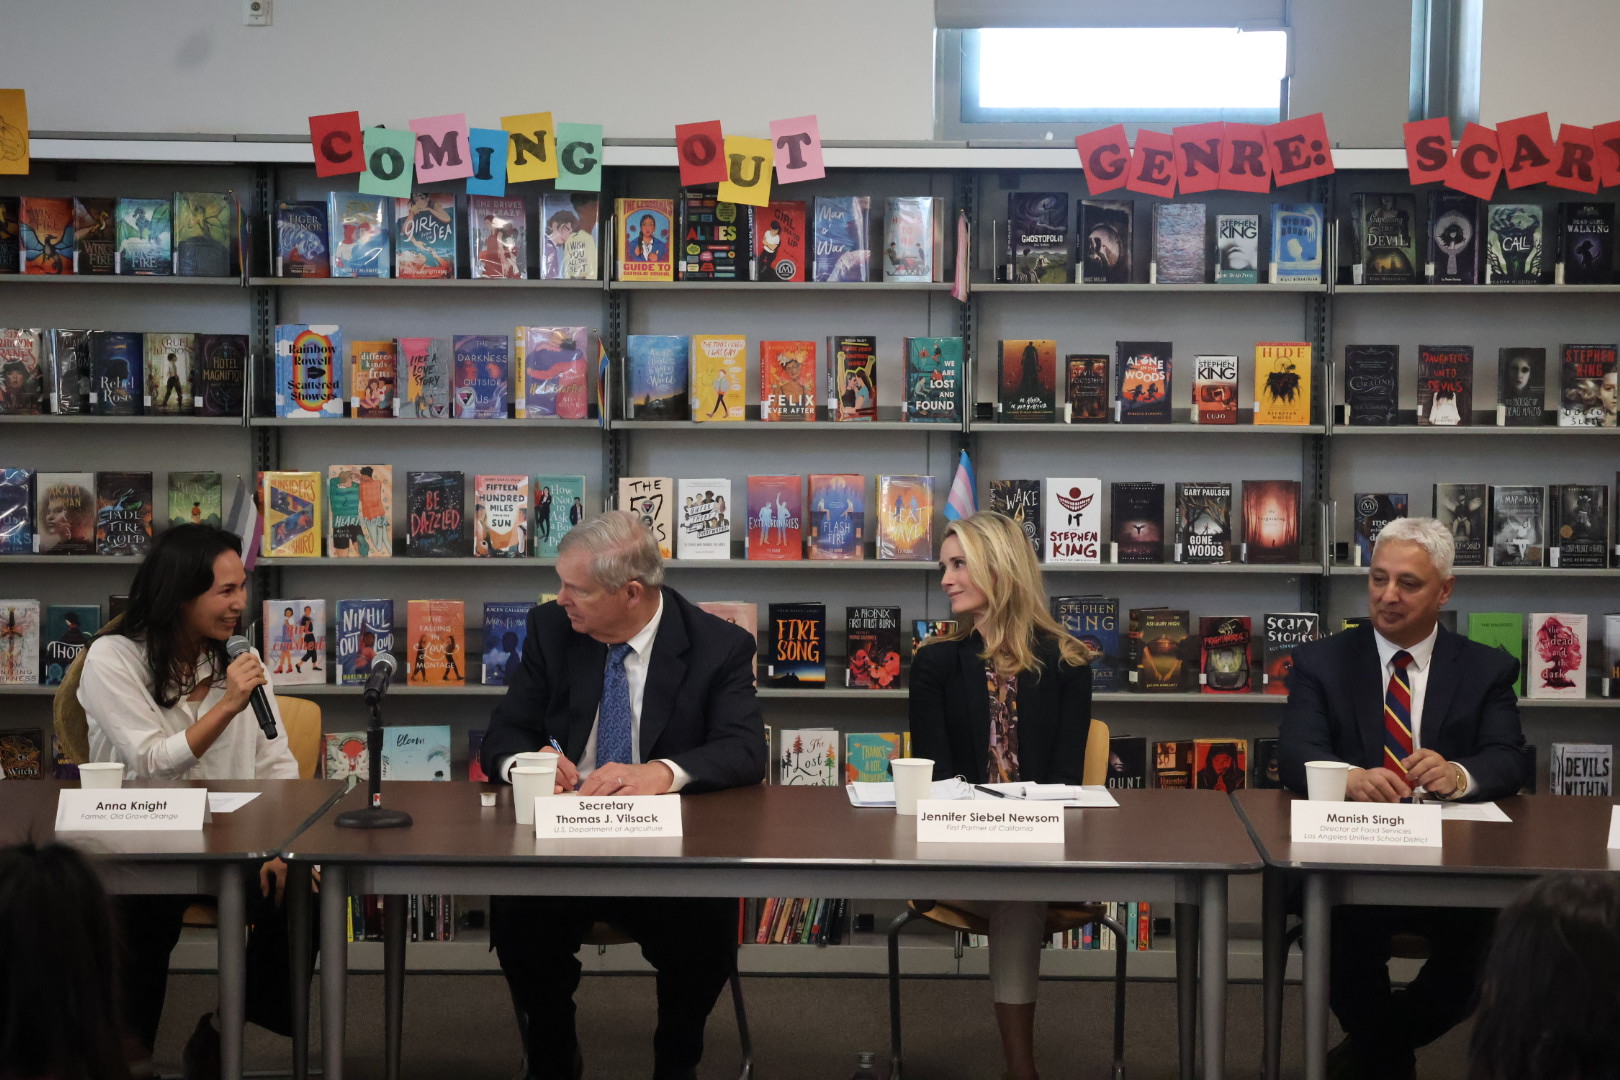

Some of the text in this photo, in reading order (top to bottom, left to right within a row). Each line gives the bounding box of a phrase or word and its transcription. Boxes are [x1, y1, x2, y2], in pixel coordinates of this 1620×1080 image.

[321, 130, 812, 187] COMING OUT
[1088, 134, 1327, 186] GENRE:
[494, 200, 522, 208] DRIVES
[289, 214, 318, 224] TIGER
[774, 208, 796, 230] GIRL
[820, 206, 845, 220] Man
[430, 224, 453, 243] SEA
[1219, 226, 1257, 239] KING
[1567, 224, 1610, 233] WALKING
[570, 242, 586, 250] WISH
[787, 238, 798, 248] UP
[1367, 233, 1409, 247] DEVIL
[1502, 236, 1531, 252] CALL
[816, 239, 846, 256] War
[569, 251, 585, 259] YOU
[569, 264, 587, 273] BEST
[624, 263, 671, 272] GUIDE TO
[288, 343, 337, 355] Rainbow
[475, 340, 489, 348] THE
[457, 353, 508, 362] DARKNESS
[1262, 347, 1305, 358] HIDE
[1422, 352, 1469, 364] DAUGHTERS
[1565, 349, 1616, 363] STEPHEN
[213, 357, 238, 369] HOTEL
[294, 355, 331, 366] Rowell
[410, 353, 430, 367] LIKE
[1126, 356, 1164, 369] ALONE
[413, 364, 434, 376] LOVE
[1147, 366, 1158, 374] THE
[1198, 368, 1236, 379] KING
[1433, 368, 1457, 377] UNTO
[1576, 364, 1603, 377] KING
[414, 375, 440, 386] STORY
[463, 378, 502, 387] OUTSIDE
[1125, 369, 1165, 384] WOODS
[101, 376, 134, 390] Rebel
[287, 379, 339, 391] Scattered
[929, 379, 955, 389] LOST
[1350, 376, 1394, 391] CORALINE
[1427, 381, 1463, 393] DEVILS
[103, 390, 132, 405] Rose
[290, 390, 338, 402] Showers
[768, 394, 815, 406] FELIX
[915, 400, 955, 411] FOUND
[51, 484, 81, 496] AKATA
[551, 485, 573, 496] How
[629, 481, 662, 494] THE
[1184, 489, 1230, 497] GARY PAULSEN
[426, 490, 440, 511] BE
[479, 494, 525, 502] HUNDRED
[1006, 488, 1038, 510] WAKE
[1505, 495, 1539, 504] MAP DAYS
[630, 494, 663, 520] 57
[549, 511, 568, 522] Ask
[888, 506, 925, 522] HEAT
[334, 515, 388, 528] HEARTSTOPPER
[411, 509, 460, 537] DAZZLED
[491, 519, 511, 527] SUN
[823, 521, 851, 533] FLASH
[1067, 514, 1083, 528] IT
[106, 534, 145, 546] GOLD
[1049, 531, 1098, 543] STEPHEN
[1190, 536, 1213, 545] GONE
[1053, 543, 1097, 559] KING
[1187, 544, 1224, 557] WOODS
[855, 608, 890, 619] A PHOENIX
[1060, 604, 1114, 614] STEPHEN
[343, 607, 391, 632] NIKHIL
[849, 618, 896, 629] FIRST MUST BURN
[1060, 615, 1115, 631] KING
[1267, 616, 1315, 634] Scary
[777, 619, 820, 640] FIRE
[1548, 626, 1558, 634] the
[373, 634, 394, 651] LOUD
[1267, 630, 1314, 643] Stories
[1551, 635, 1573, 645] dead
[273, 638, 326, 651] crushed
[339, 635, 359, 656] OUT
[414, 642, 460, 660] Love
[777, 640, 821, 664] SONG
[1552, 648, 1566, 656] and
[1557, 659, 1568, 667] the
[1542, 667, 1565, 679] dark
[396, 733, 425, 747] Bloom
[807, 738, 824, 753] The
[861, 745, 886, 760] THANKS
[794, 753, 823, 777] Lost
[1565, 757, 1609, 778] DEVILS
[1160, 776, 1188, 785] Haunted
[1565, 781, 1609, 796] WITHIN
[96, 800, 167, 813] Anna Knight
[579, 801, 634, 812] Secretary
[150, 813, 179, 822] Orange
[556, 813, 659, 824] Thomas J. Vilsack
[921, 811, 1059, 823] Jennifer Siebel Newsom
[1326, 813, 1405, 826] Manish Singh
[568, 826, 612, 834] Department
[623, 825, 663, 834] Agriculture
[946, 824, 959, 832] First
[998, 824, 1034, 832] California
[1377, 826, 1412, 834] Services
[1318, 833, 1348, 842] Angeles
[1377, 834, 1402, 842] School
[1402, 835, 1428, 843] District
